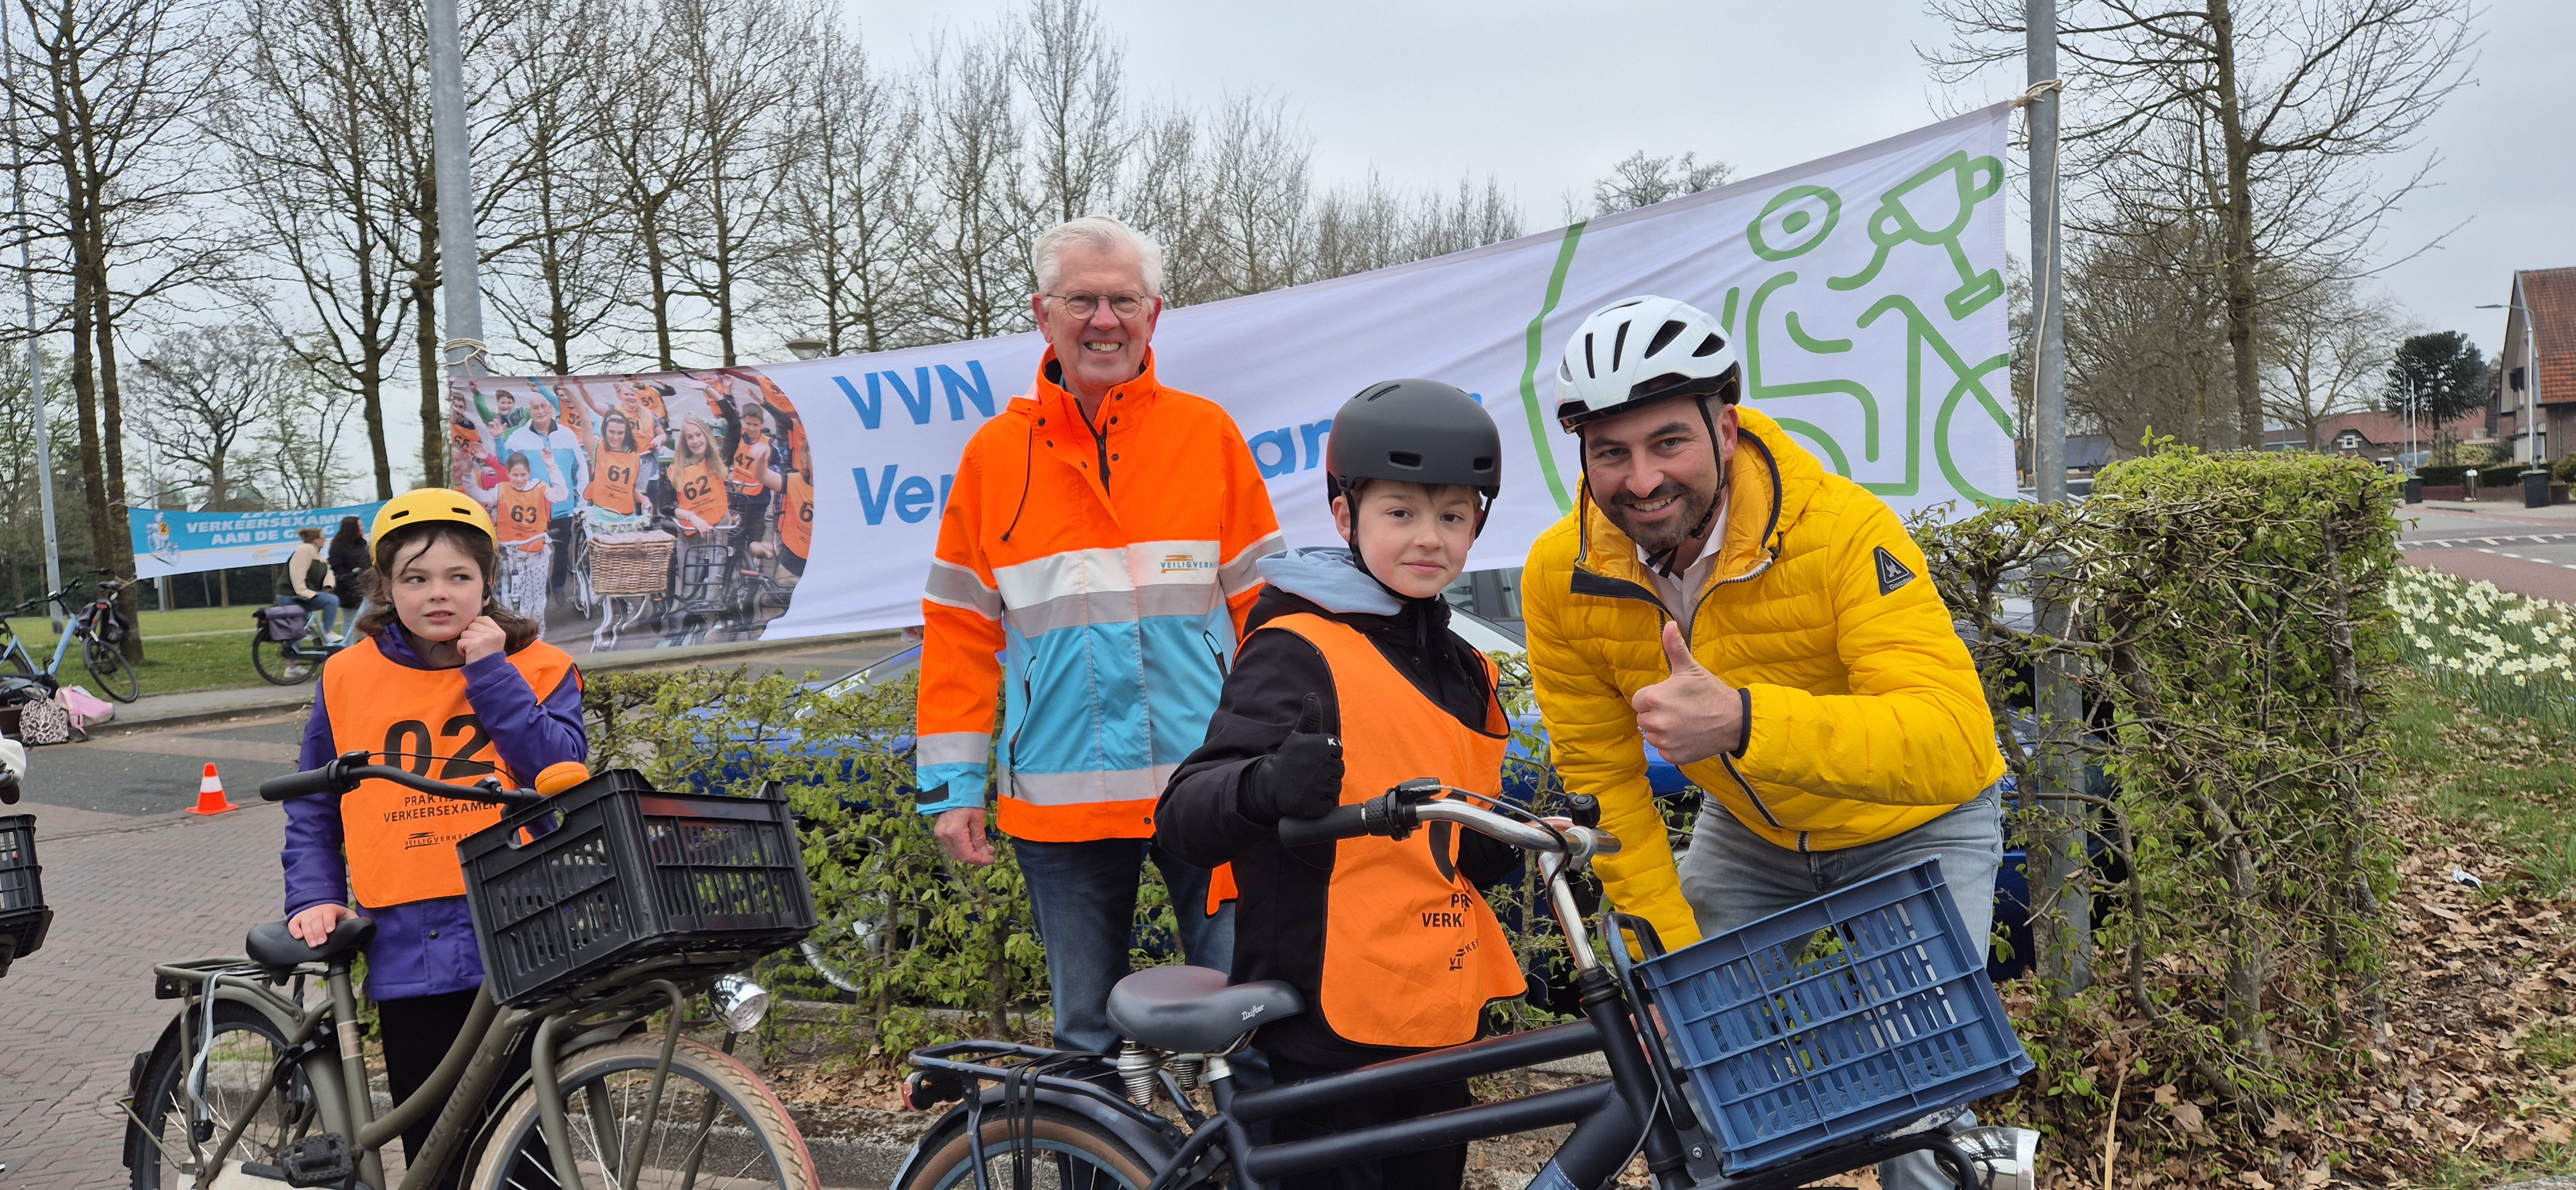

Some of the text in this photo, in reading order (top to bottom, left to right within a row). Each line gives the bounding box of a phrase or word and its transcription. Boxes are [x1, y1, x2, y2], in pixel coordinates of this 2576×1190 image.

[831, 360, 996, 430] VVN
[735, 453, 755, 470] 47
[608, 465, 630, 484] 61
[683, 475, 712, 500] 62
[511, 505, 536, 524] 63
[160, 524, 167, 533] 2
[211, 525, 334, 545] AAN DE GG
[384, 713, 495, 780] 02
[383, 802, 497, 823] VERKEERSEXAMEN
[1422, 912, 1465, 927] VERK
[1241, 1004, 1265, 1021] Drifter
